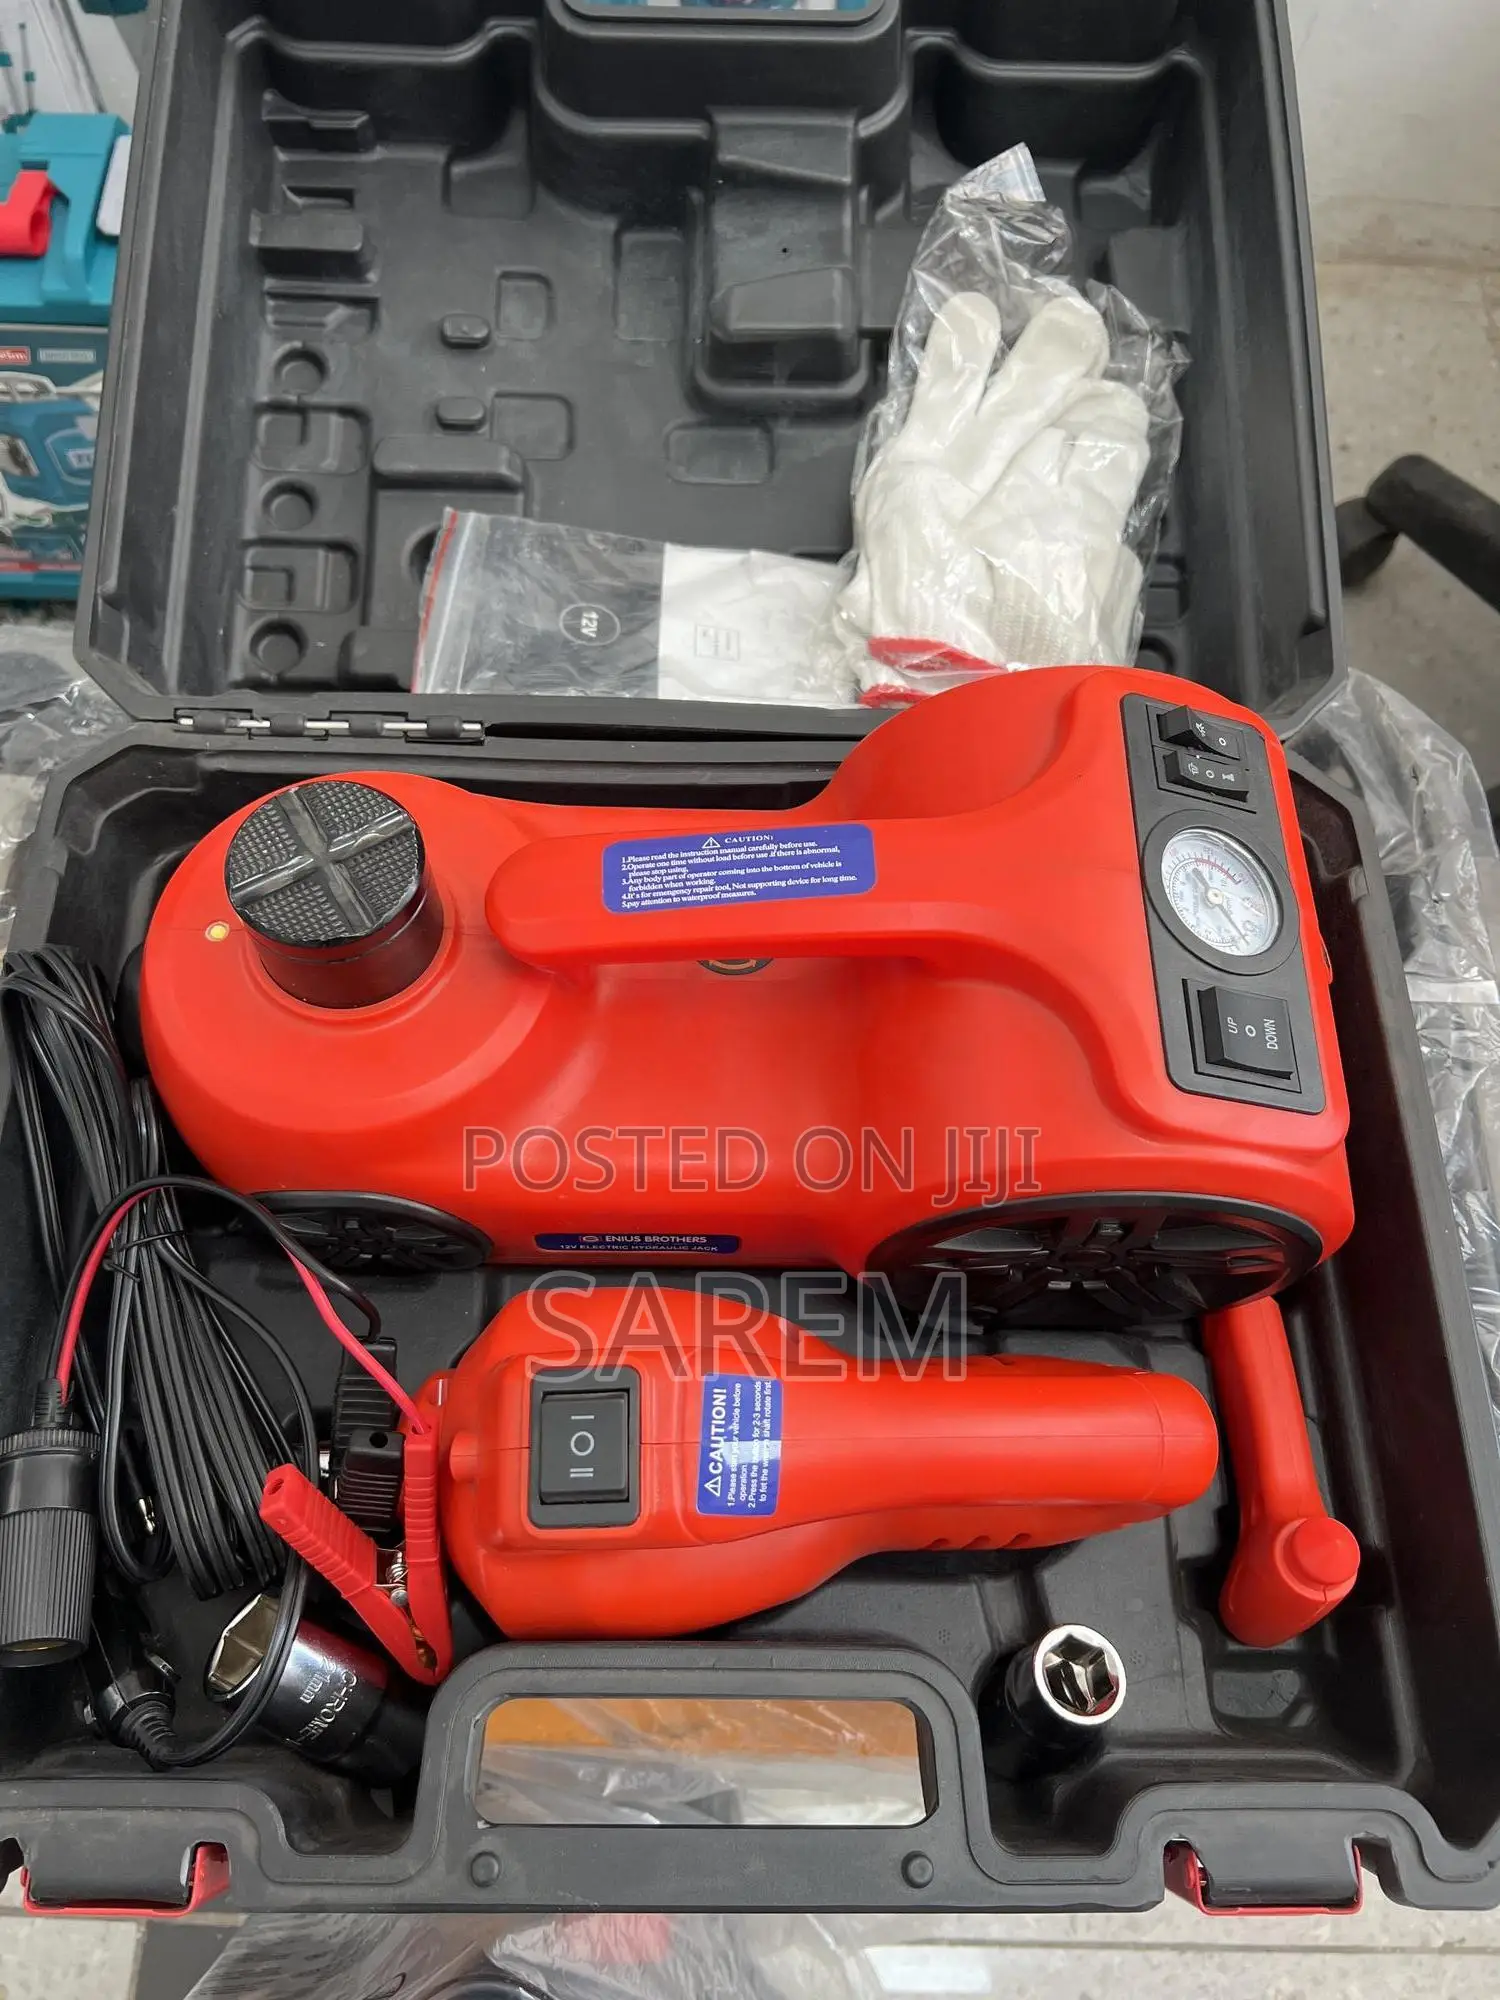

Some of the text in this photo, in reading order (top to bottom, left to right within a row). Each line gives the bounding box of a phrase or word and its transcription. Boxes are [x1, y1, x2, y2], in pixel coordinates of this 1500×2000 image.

[580, 611, 599, 638] 12V
[680, 849, 718, 857] instruction
[748, 844, 777, 852] carefully
[629, 870, 650, 878] please
[687, 872, 717, 880] operator
[718, 869, 745, 877] coming
[811, 861, 834, 869] vehicle
[629, 883, 663, 891] forbidden
[693, 886, 713, 894] repair
[747, 880, 786, 889] supporting
[682, 893, 720, 902] waterproof
[1227, 1016, 1238, 1034] UP
[1263, 1018, 1279, 1050] DOWN
[644, 1235, 708, 1243] BROTHERS
[733, 1383, 742, 1406] before
[754, 1381, 762, 1411] seconds
[732, 1408, 740, 1433] vehicle
[763, 1418, 771, 1437] shaft
[709, 1388, 727, 1474] CAUTION!
[752, 1427, 760, 1437] for
